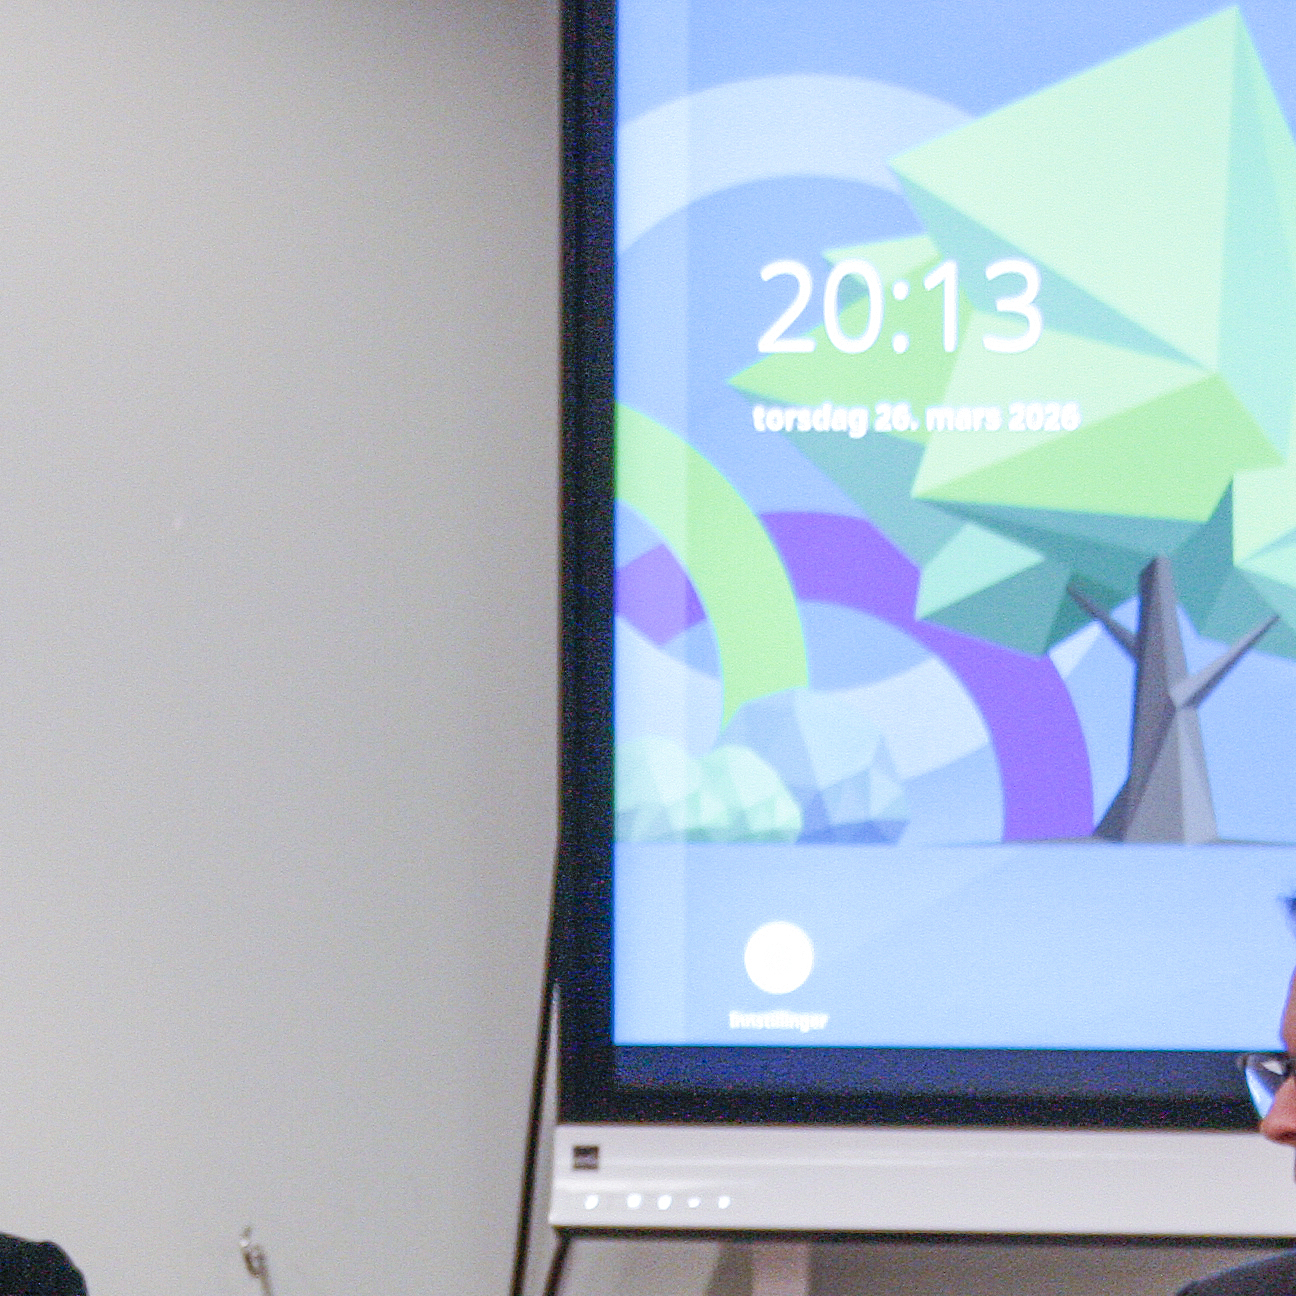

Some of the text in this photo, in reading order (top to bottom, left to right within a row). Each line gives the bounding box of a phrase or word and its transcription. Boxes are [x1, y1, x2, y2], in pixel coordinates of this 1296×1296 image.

[757, 258, 1044, 353] 20:13
[752, 402, 1081, 438] torsdag 26. mars 2026
